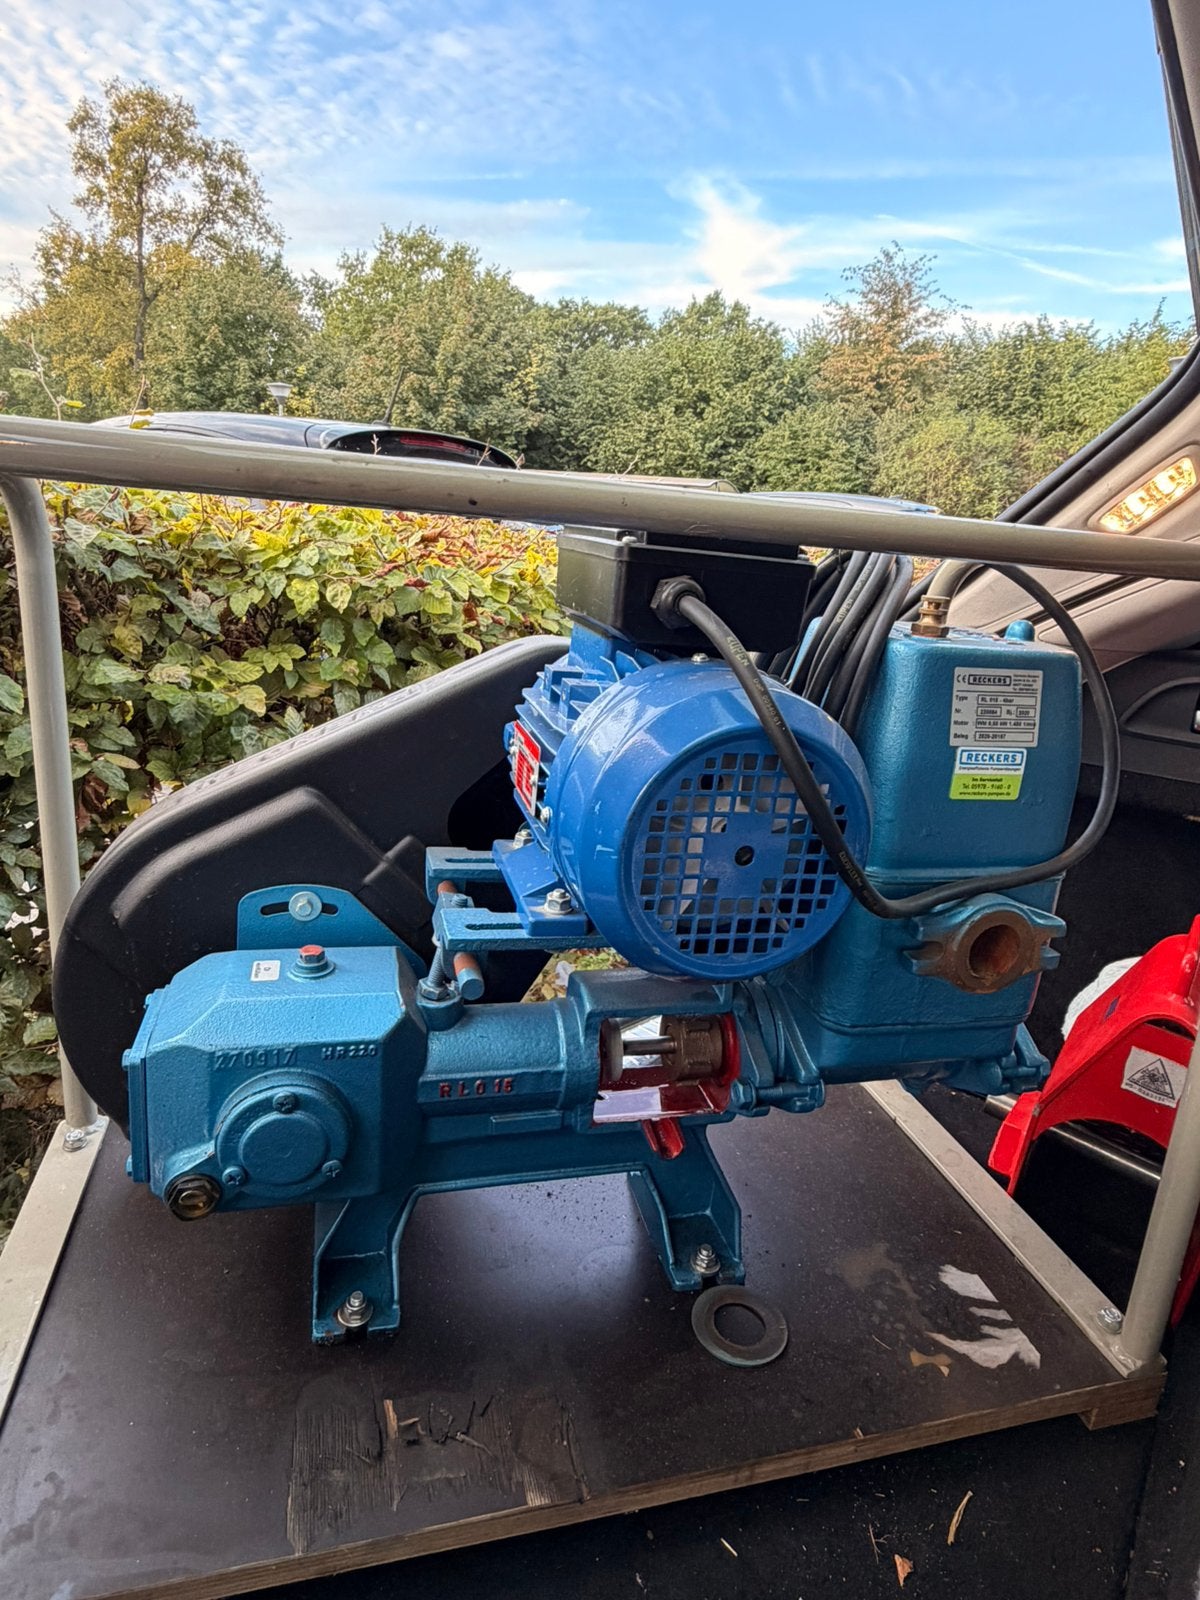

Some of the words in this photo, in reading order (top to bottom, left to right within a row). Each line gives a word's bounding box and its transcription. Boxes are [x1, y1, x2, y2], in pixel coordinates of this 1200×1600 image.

[972, 676, 1007, 685] RECKERS
[955, 694, 969, 702] Type
[966, 752, 1018, 763] RECKERS
